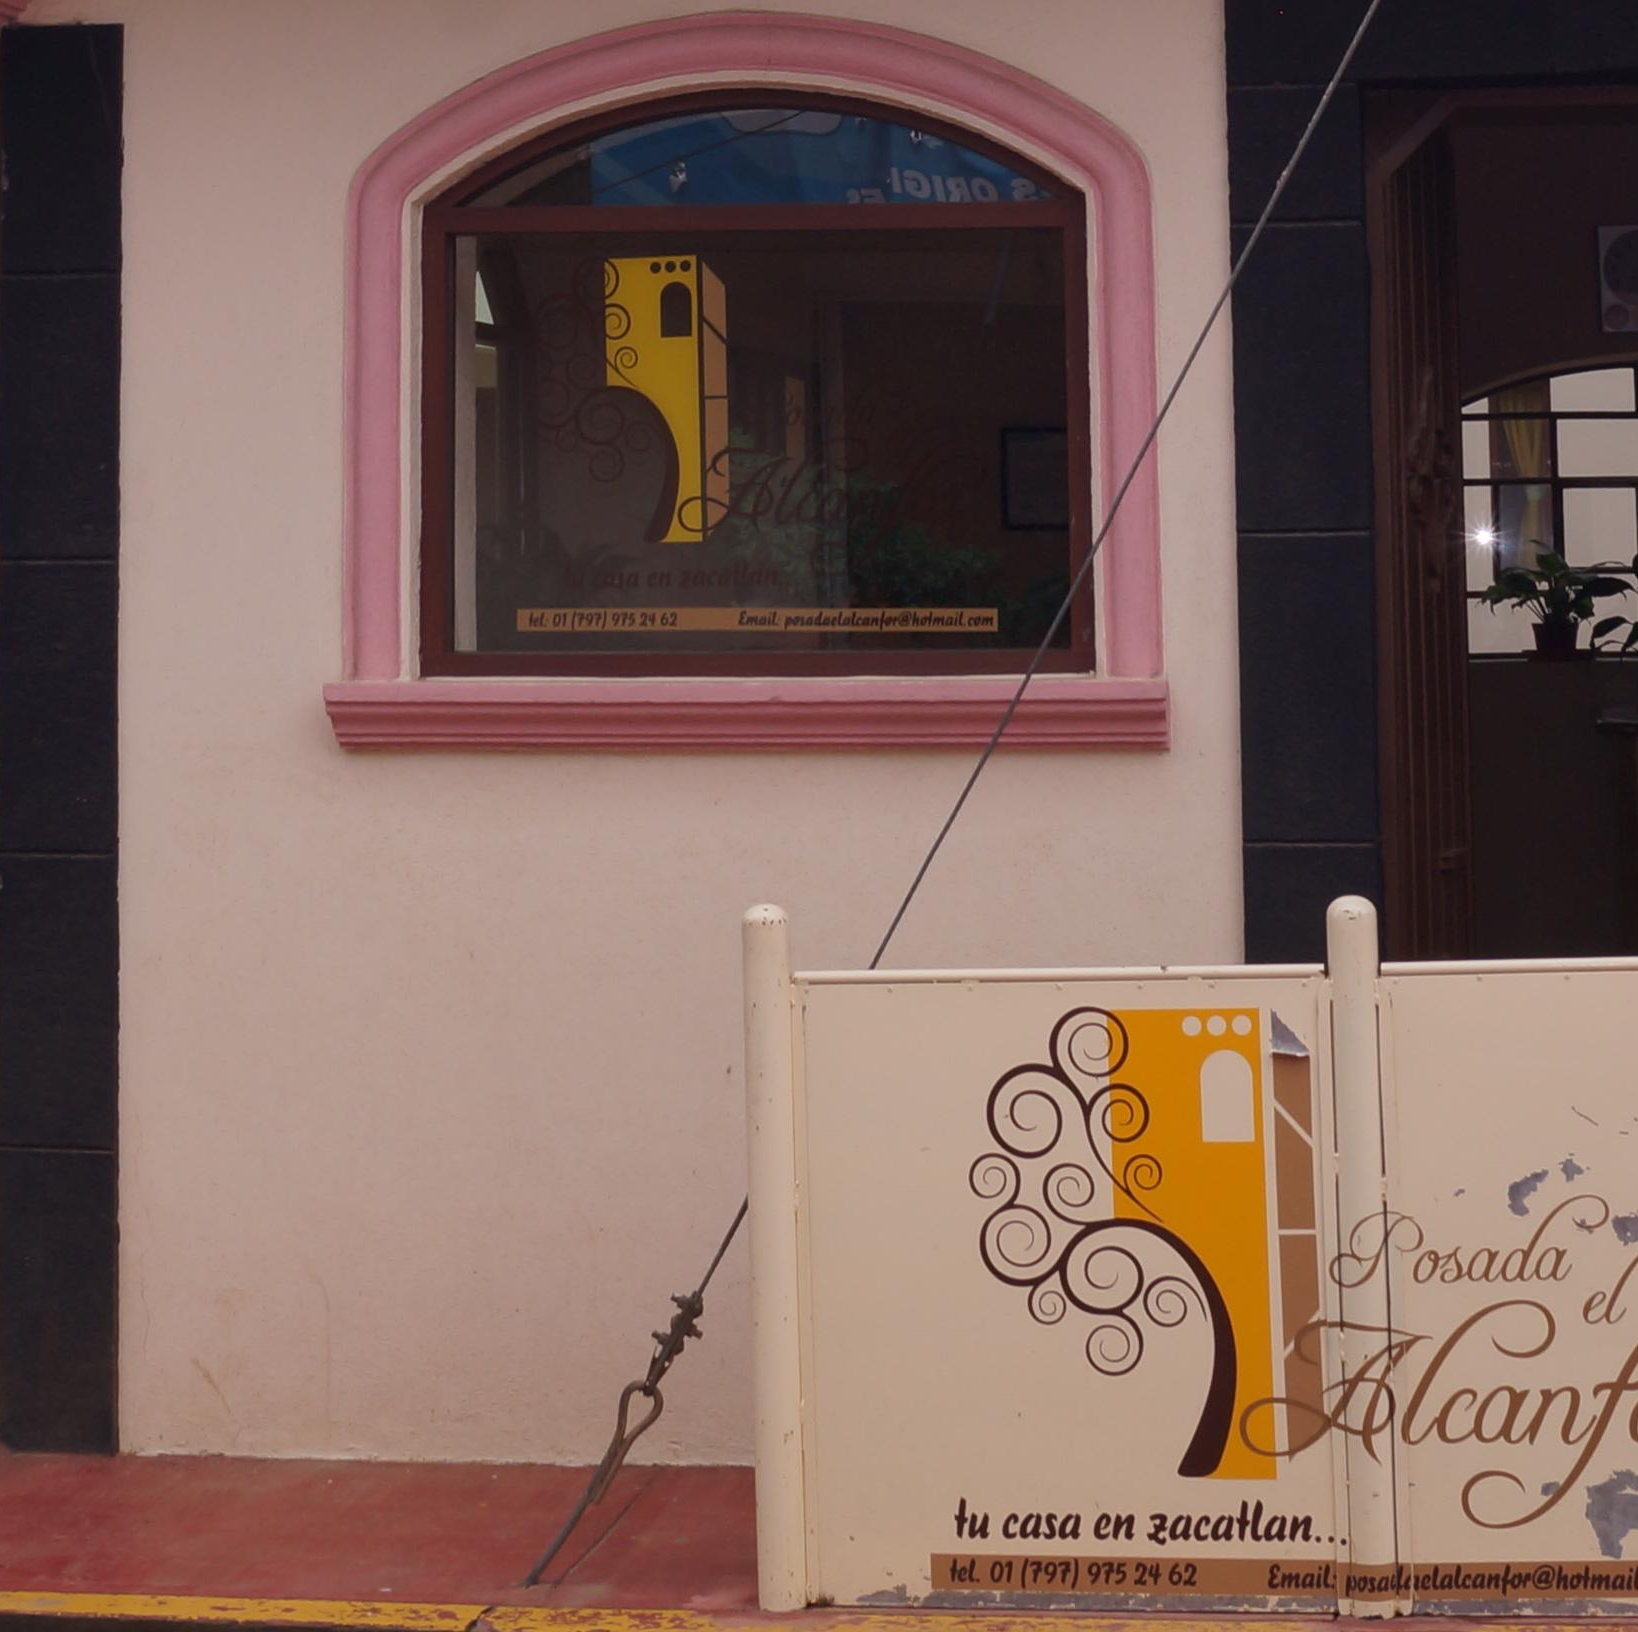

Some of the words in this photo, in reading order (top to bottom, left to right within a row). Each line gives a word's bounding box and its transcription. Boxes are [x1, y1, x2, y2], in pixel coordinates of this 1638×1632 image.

[553, 612, 567, 628] 01
[571, 610, 608, 630] (797)
[613, 612, 636, 627] 975
[639, 612, 656, 627] 24
[660, 612, 678, 627] 62
[1329, 1194, 1610, 1290] Posada
[954, 1497, 990, 1540] tu
[1002, 1510, 1081, 1540] casa
[1094, 1512, 1136, 1540] en
[990, 1561, 1014, 1584] 01
[1020, 1558, 1079, 1589] (797)
[1087, 1561, 1127, 1586] 975
[1134, 1562, 1163, 1587] 24
[1169, 1562, 1198, 1587] 62
[1267, 1564, 1337, 1591] Email:
